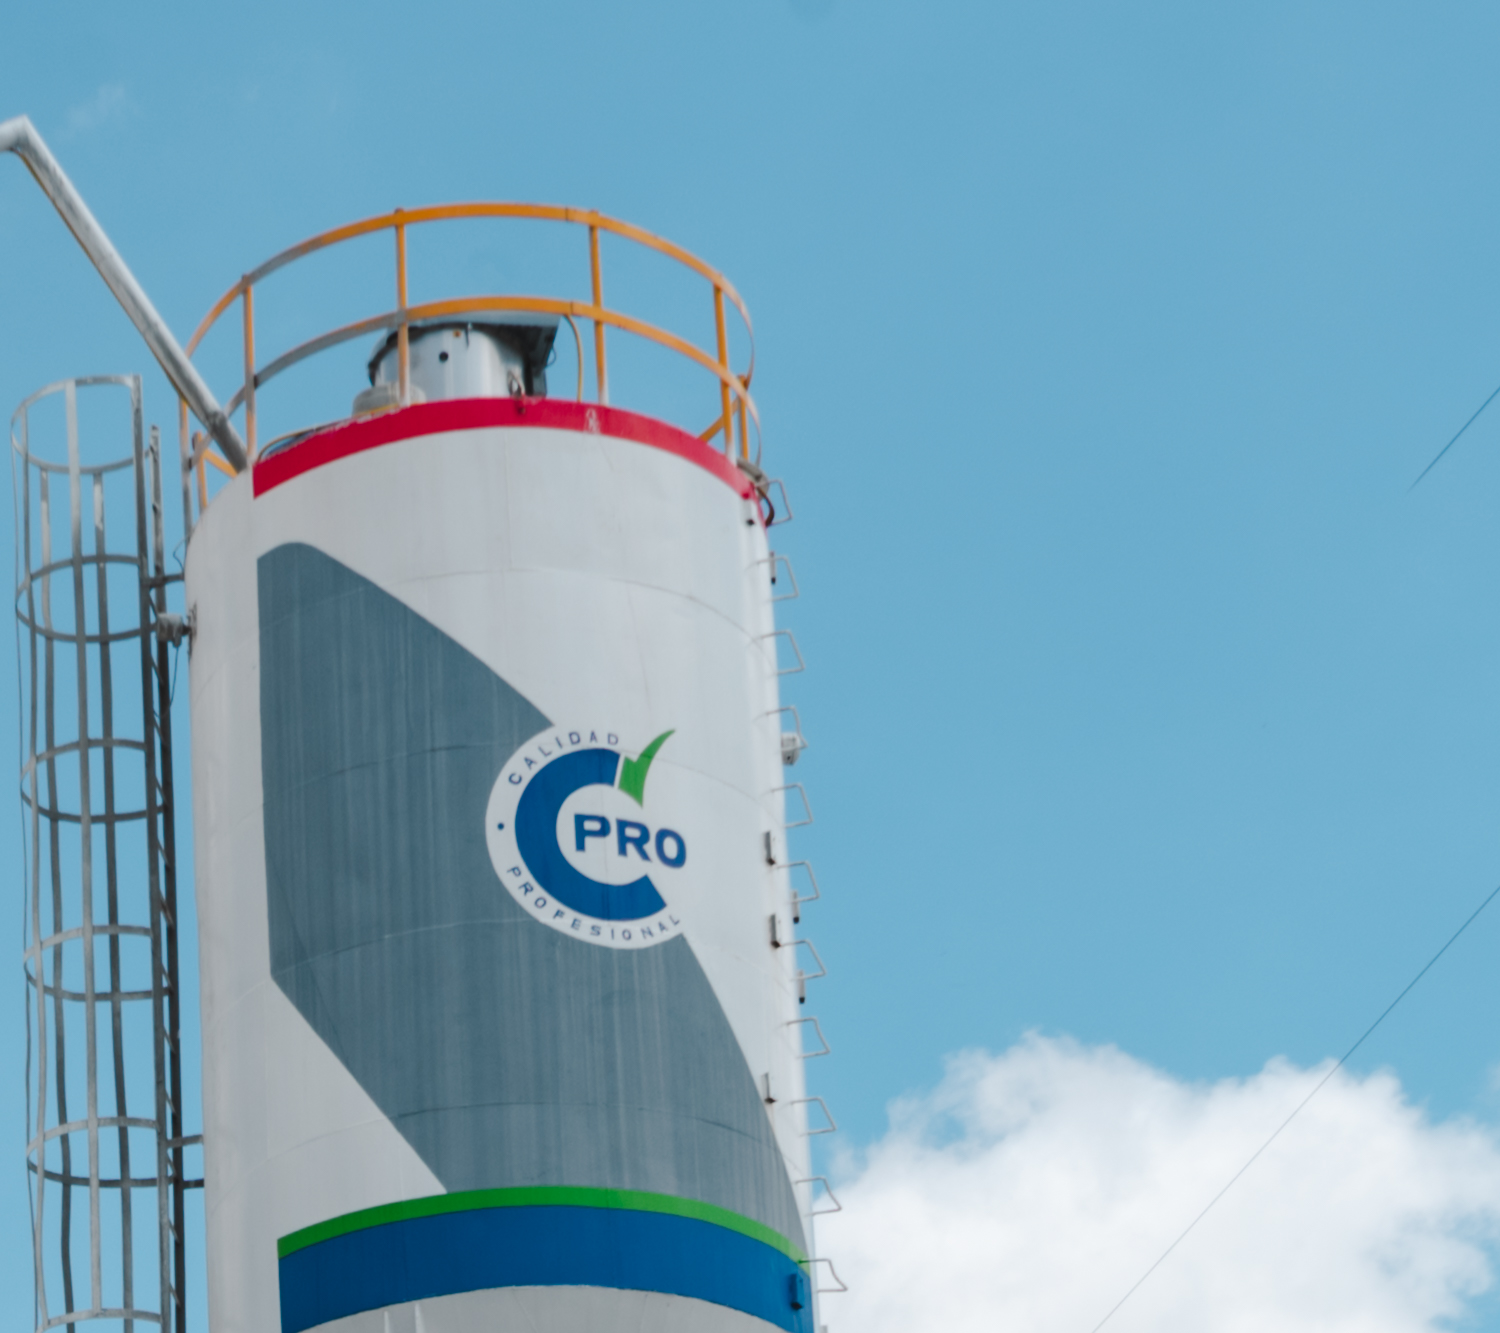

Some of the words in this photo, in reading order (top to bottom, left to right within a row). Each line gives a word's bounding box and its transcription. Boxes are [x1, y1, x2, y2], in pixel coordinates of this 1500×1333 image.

[507, 729, 620, 786] CALIDAD
[573, 812, 688, 870] PRO
[506, 865, 681, 941] PROFESIONAL
